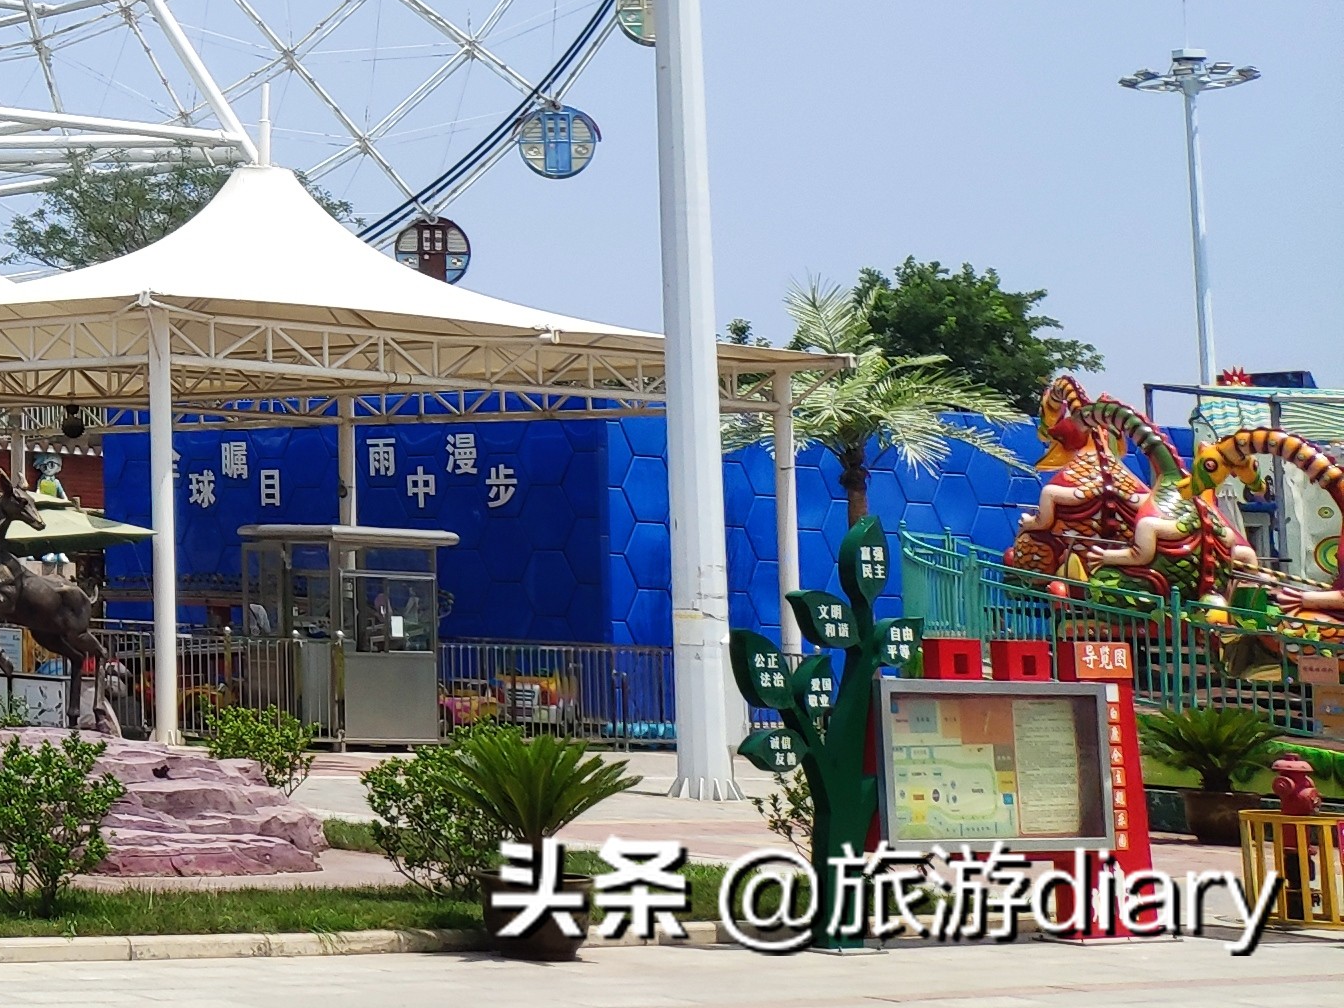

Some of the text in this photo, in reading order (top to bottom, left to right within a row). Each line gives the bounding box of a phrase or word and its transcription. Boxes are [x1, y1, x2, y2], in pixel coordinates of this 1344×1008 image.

[366, 433, 518, 508] 雨中漫步
[860, 546, 884, 562] 富强
[862, 563, 886, 579] 民主
[817, 604, 843, 620] 文明
[824, 622, 850, 638] 和谐
[889, 626, 914, 642] 自由
[887, 644, 911, 660] 平等
[754, 653, 779, 669] 公正
[759, 672, 785, 688] 法治
[810, 678, 832, 692] 爱国
[807, 694, 830, 708] 敬业
[769, 736, 792, 751] 诚信
[774, 752, 797, 767] 友善
